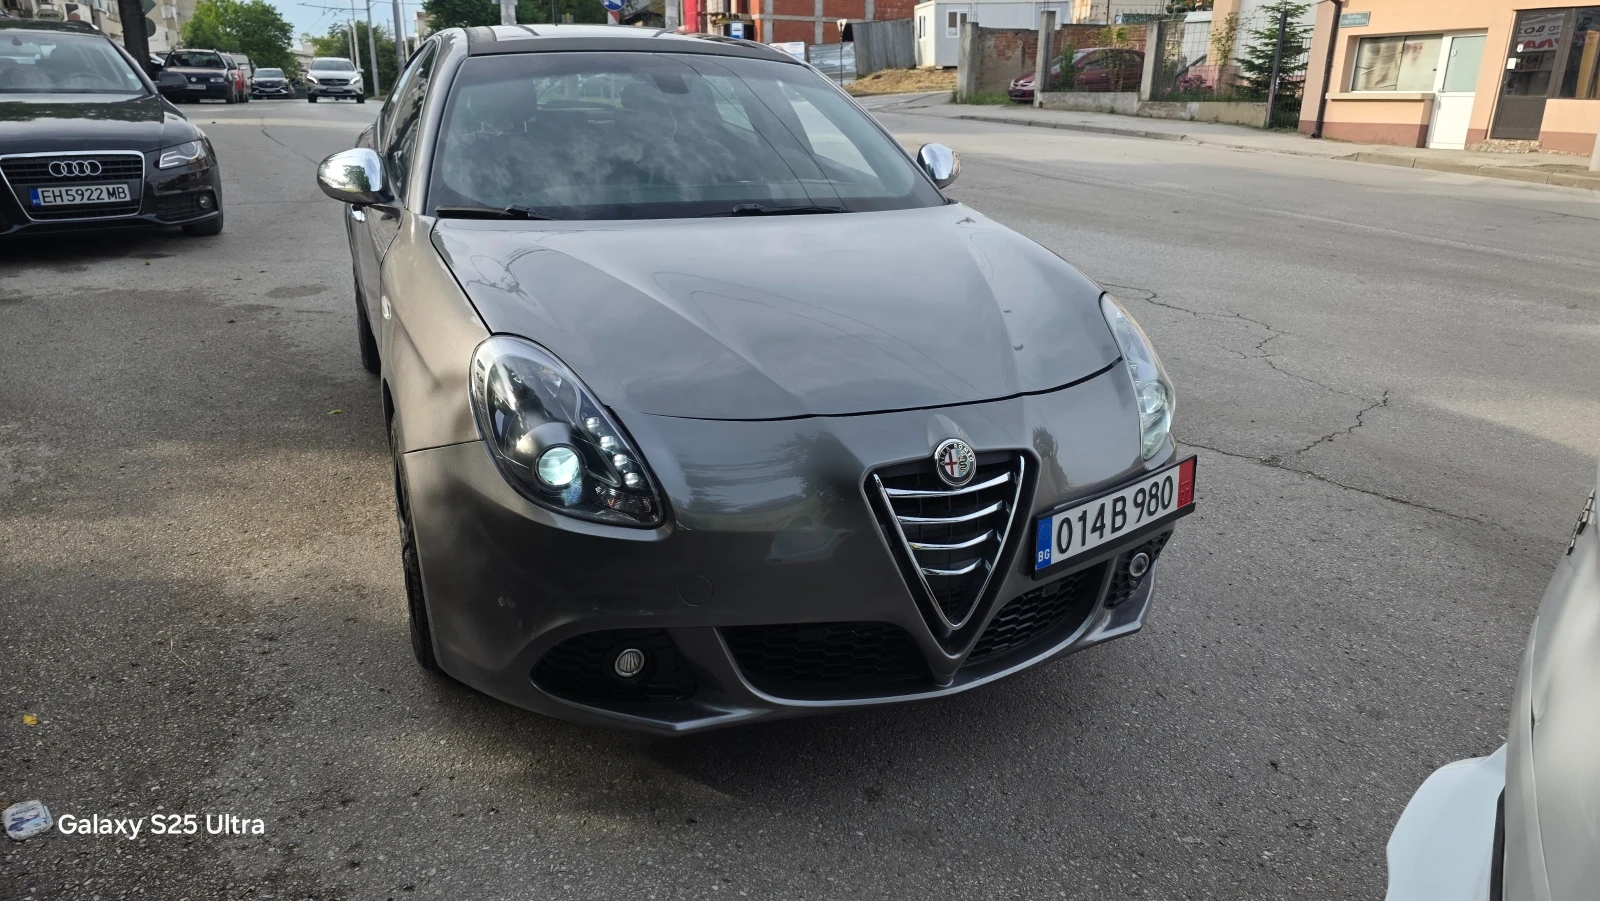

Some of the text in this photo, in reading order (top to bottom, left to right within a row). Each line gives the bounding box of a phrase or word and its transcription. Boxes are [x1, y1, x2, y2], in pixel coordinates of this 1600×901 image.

[64, 187, 105, 202] 5922
[106, 186, 127, 200] MB
[1037, 548, 1051, 563] BG
